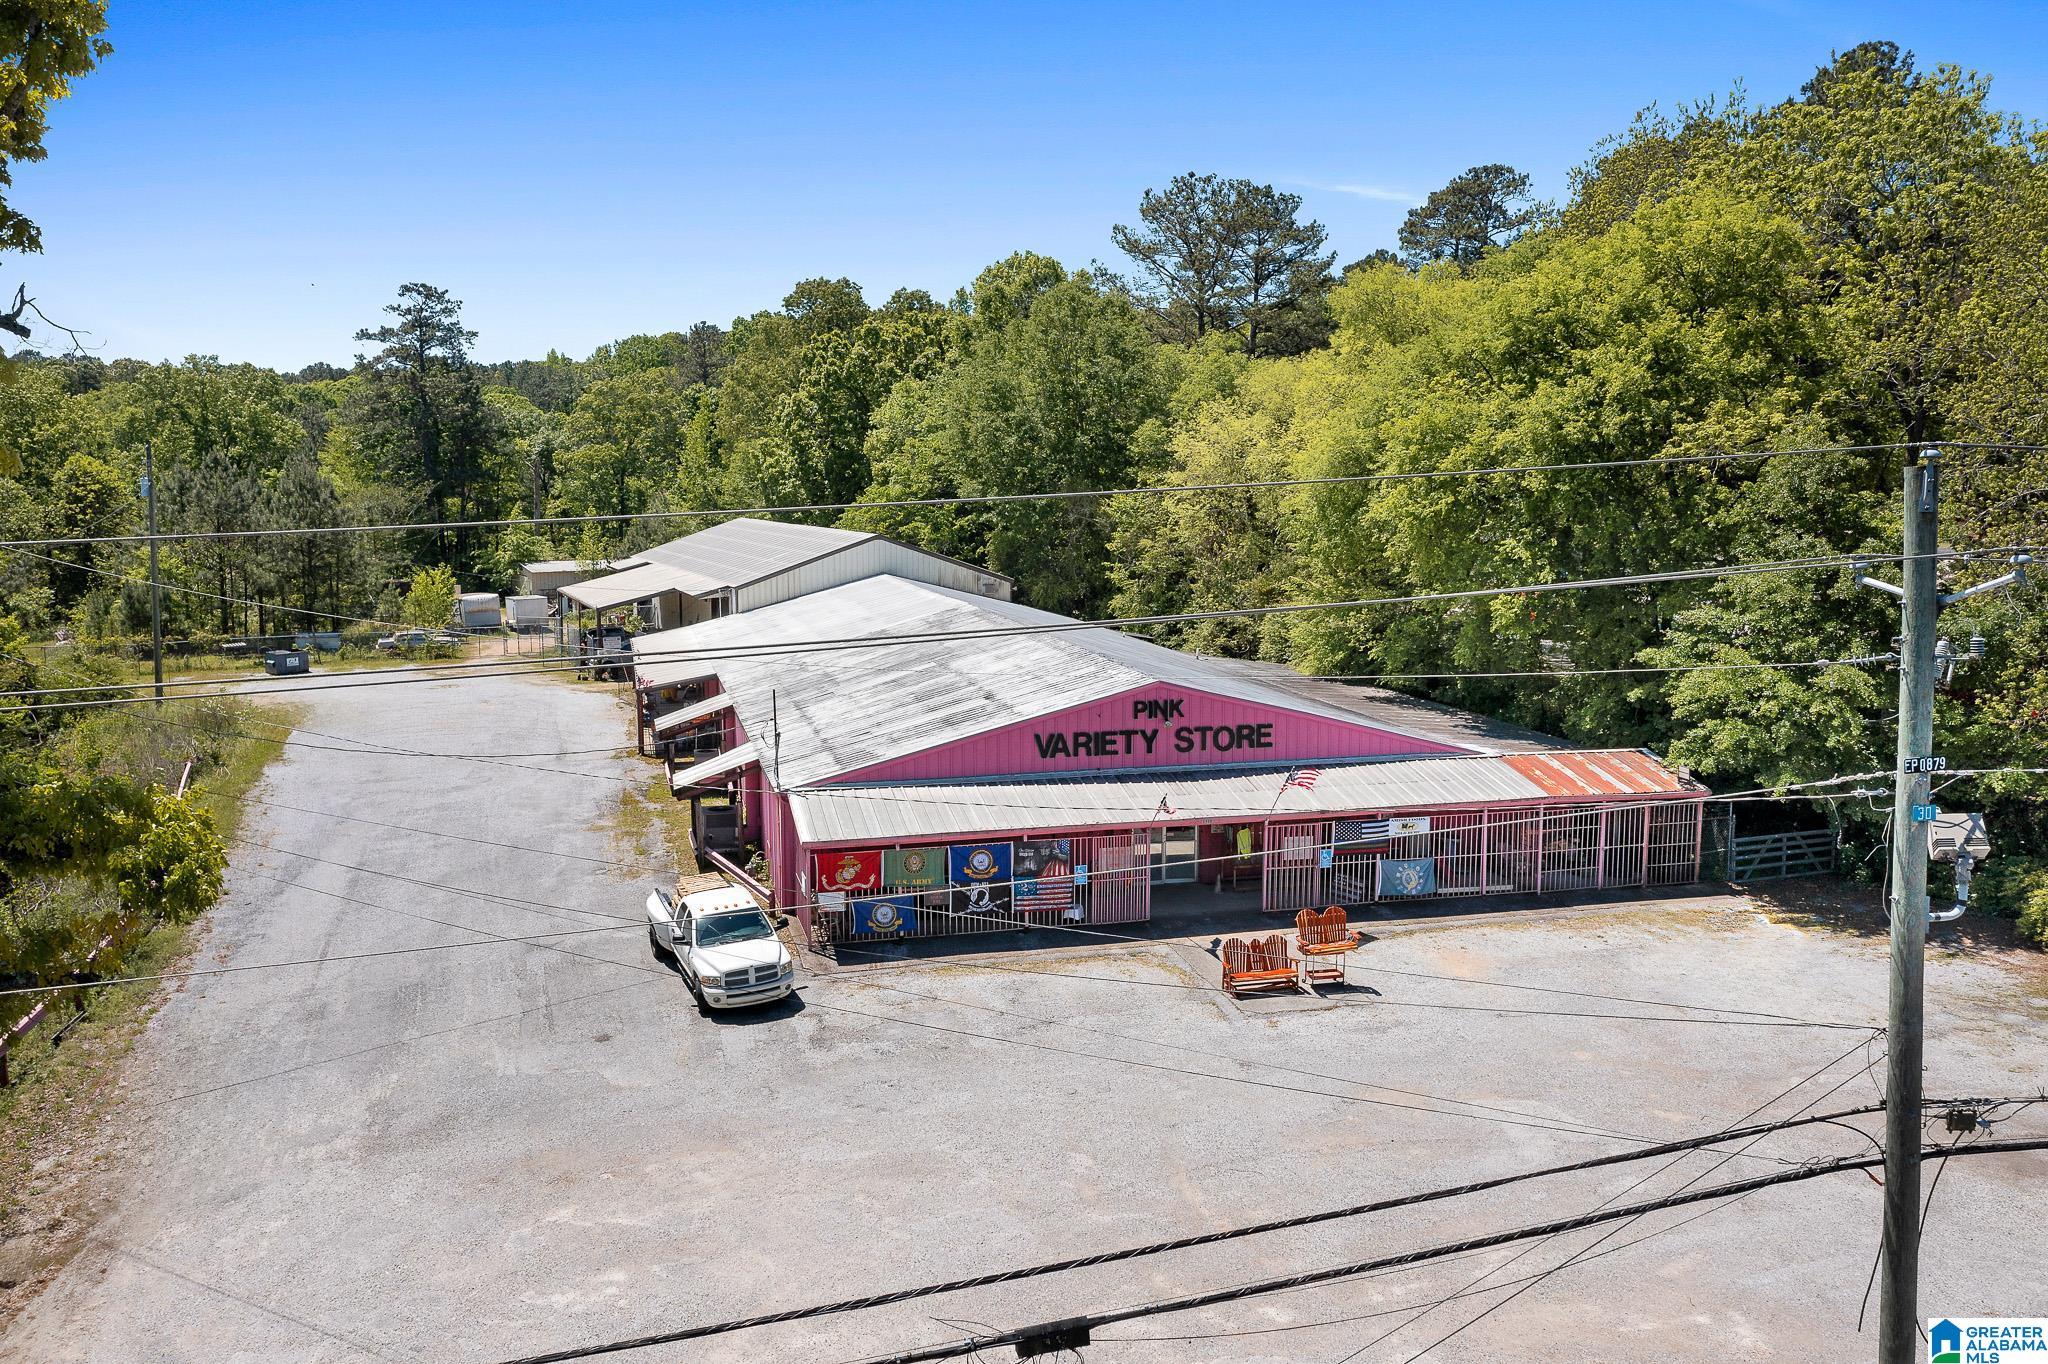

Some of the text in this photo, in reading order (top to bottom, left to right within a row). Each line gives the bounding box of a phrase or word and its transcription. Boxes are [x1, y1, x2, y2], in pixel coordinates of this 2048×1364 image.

[1133, 699, 1185, 720] PINK
[1034, 723, 1273, 758] VARIETY STORE
